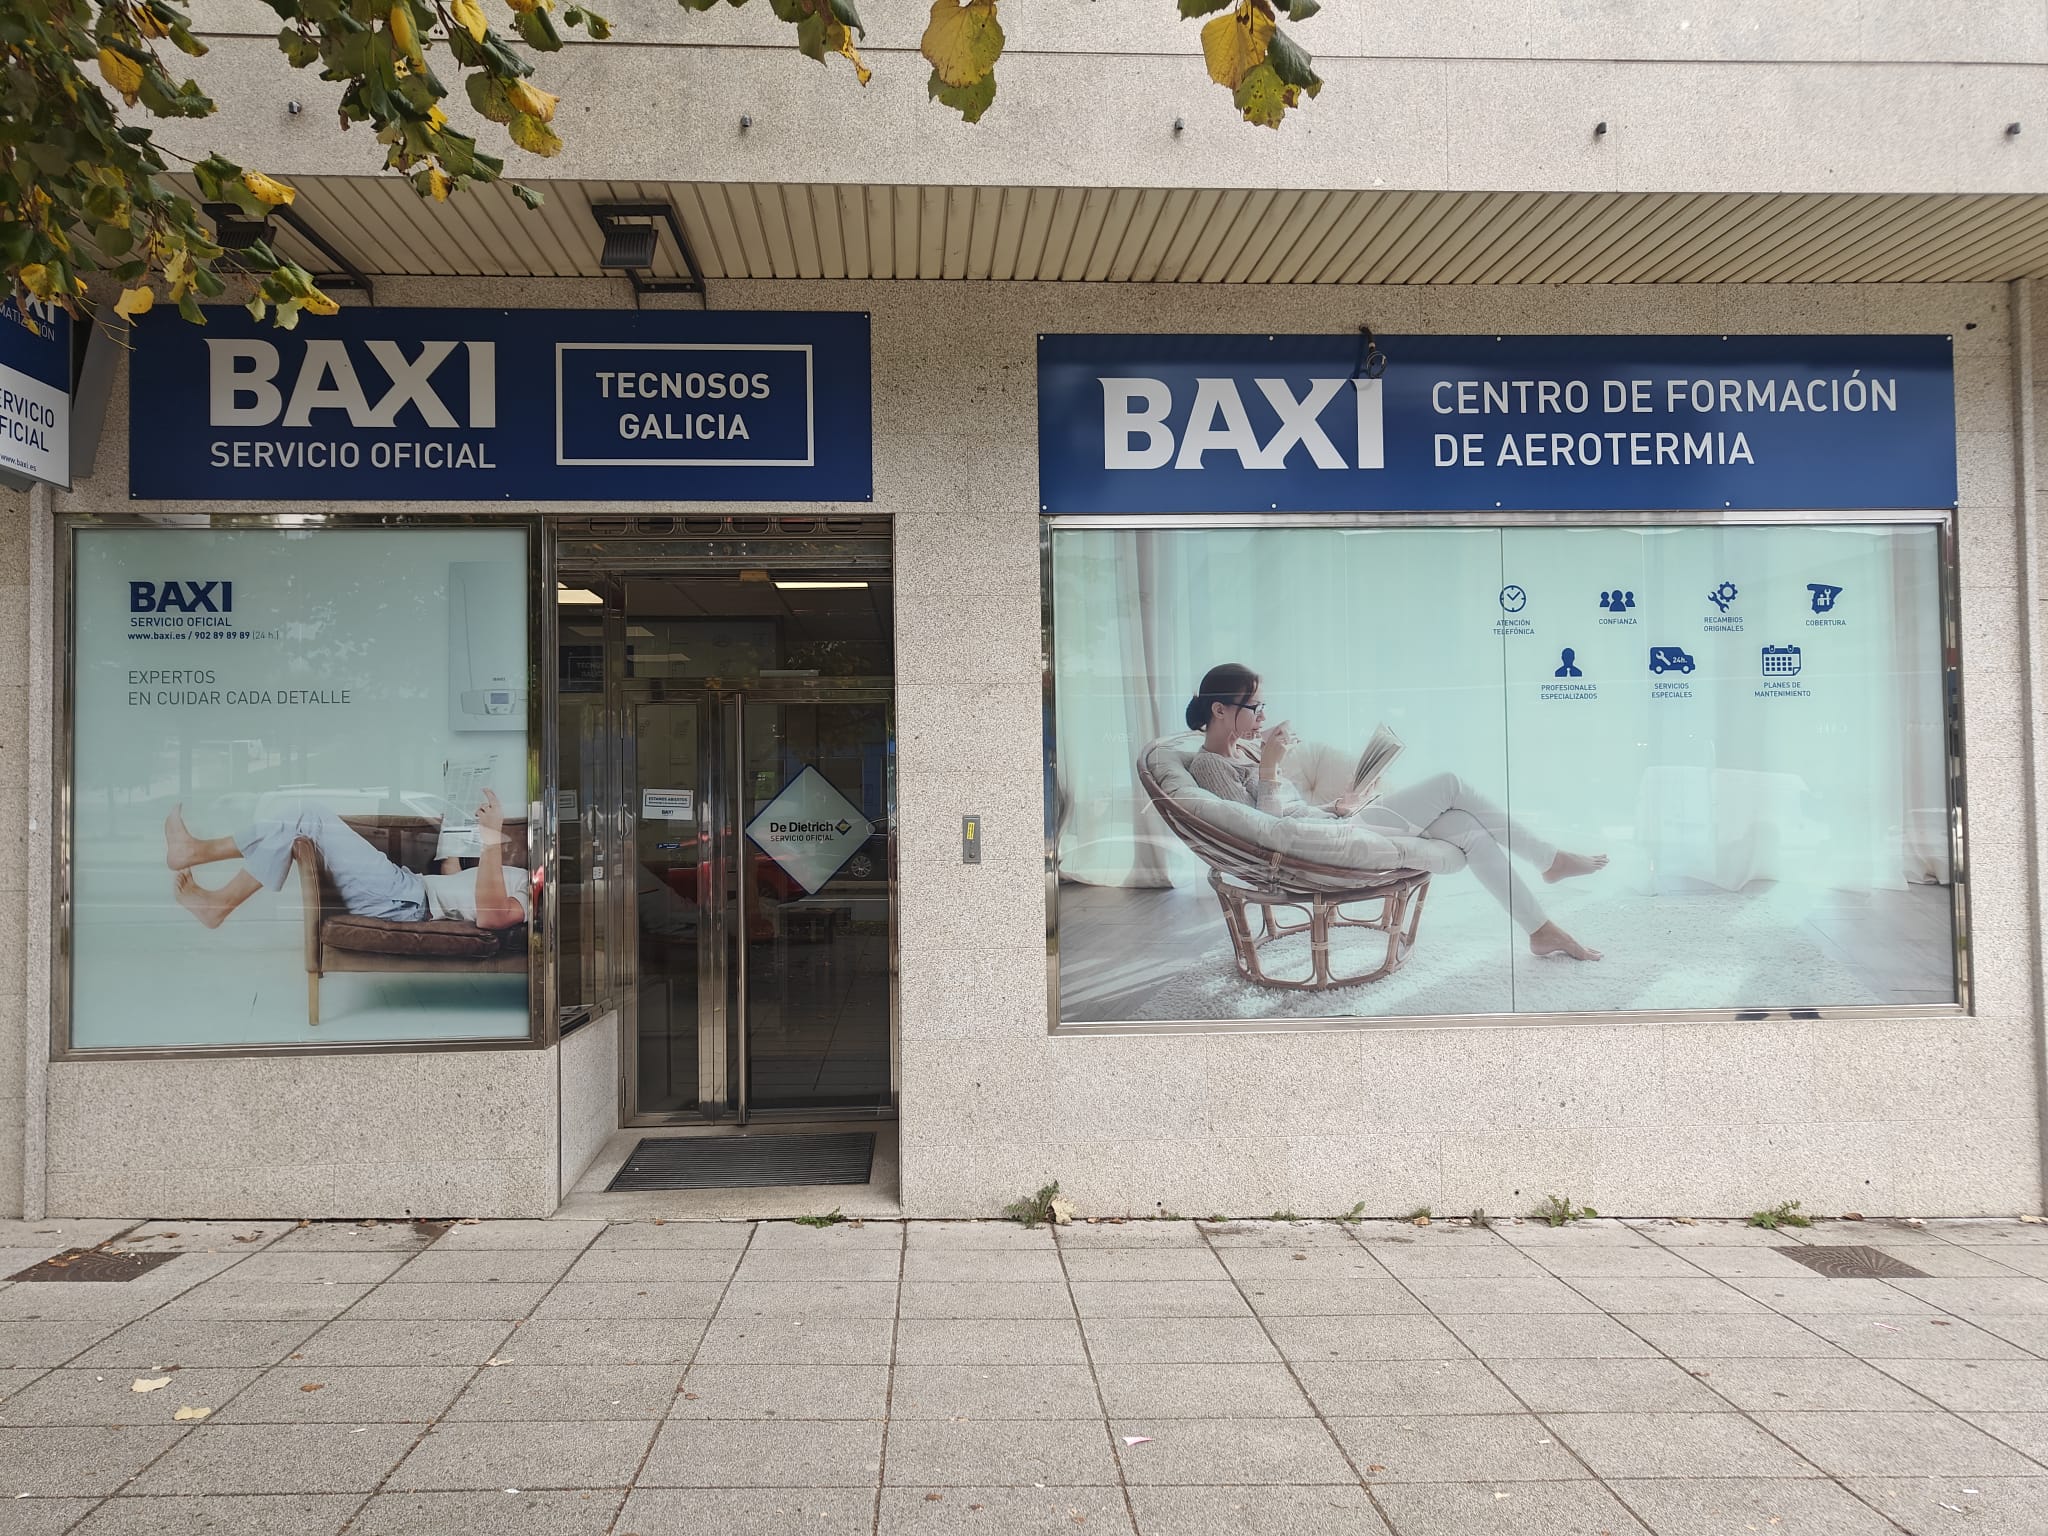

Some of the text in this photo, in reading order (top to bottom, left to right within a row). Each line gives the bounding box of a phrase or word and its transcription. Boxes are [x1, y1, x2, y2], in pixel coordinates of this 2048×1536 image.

[203, 338, 496, 428] BAXI
[595, 372, 771, 400] TECNOSOS
[1431, 369, 1897, 415] CENTRO DE FORMACIÓN
[0, 387, 55, 428] RVICIO
[619, 413, 751, 440] GALICIA
[1096, 377, 1385, 470] BAXI
[210, 441, 497, 469] SERVICIO OFICIAL
[1433, 431, 1755, 468] DE AEROTERMIA
[128, 581, 233, 613] BAXI
[130, 616, 233, 628] SERVICIO OFICIAL
[1496, 618, 1531, 626] ATENCIÓN
[127, 631, 186, 640] www.baxi.es
[194, 631, 212, 640] 902
[213, 631, 225, 640] 89
[226, 631, 238, 640] 89
[239, 631, 250, 640] 89
[1493, 627, 1535, 635] TELEFÓNICA
[1672, 656, 1688, 664] 24h.
[128, 670, 216, 685] EXPERTOS
[1541, 684, 1597, 692] PROFESIONALES
[1654, 682, 1689, 690] SERVICIOS
[1763, 681, 1791, 689] PLANES
[128, 690, 351, 706] EN CUIDAR CADA DETALLE
[1540, 692, 1598, 700] ESPECIALIZADOS
[1754, 690, 1811, 698] MANTENIMIENTO
[770, 821, 834, 833] De Dietrich
[770, 834, 834, 842] SERVICIO OFICIAL
